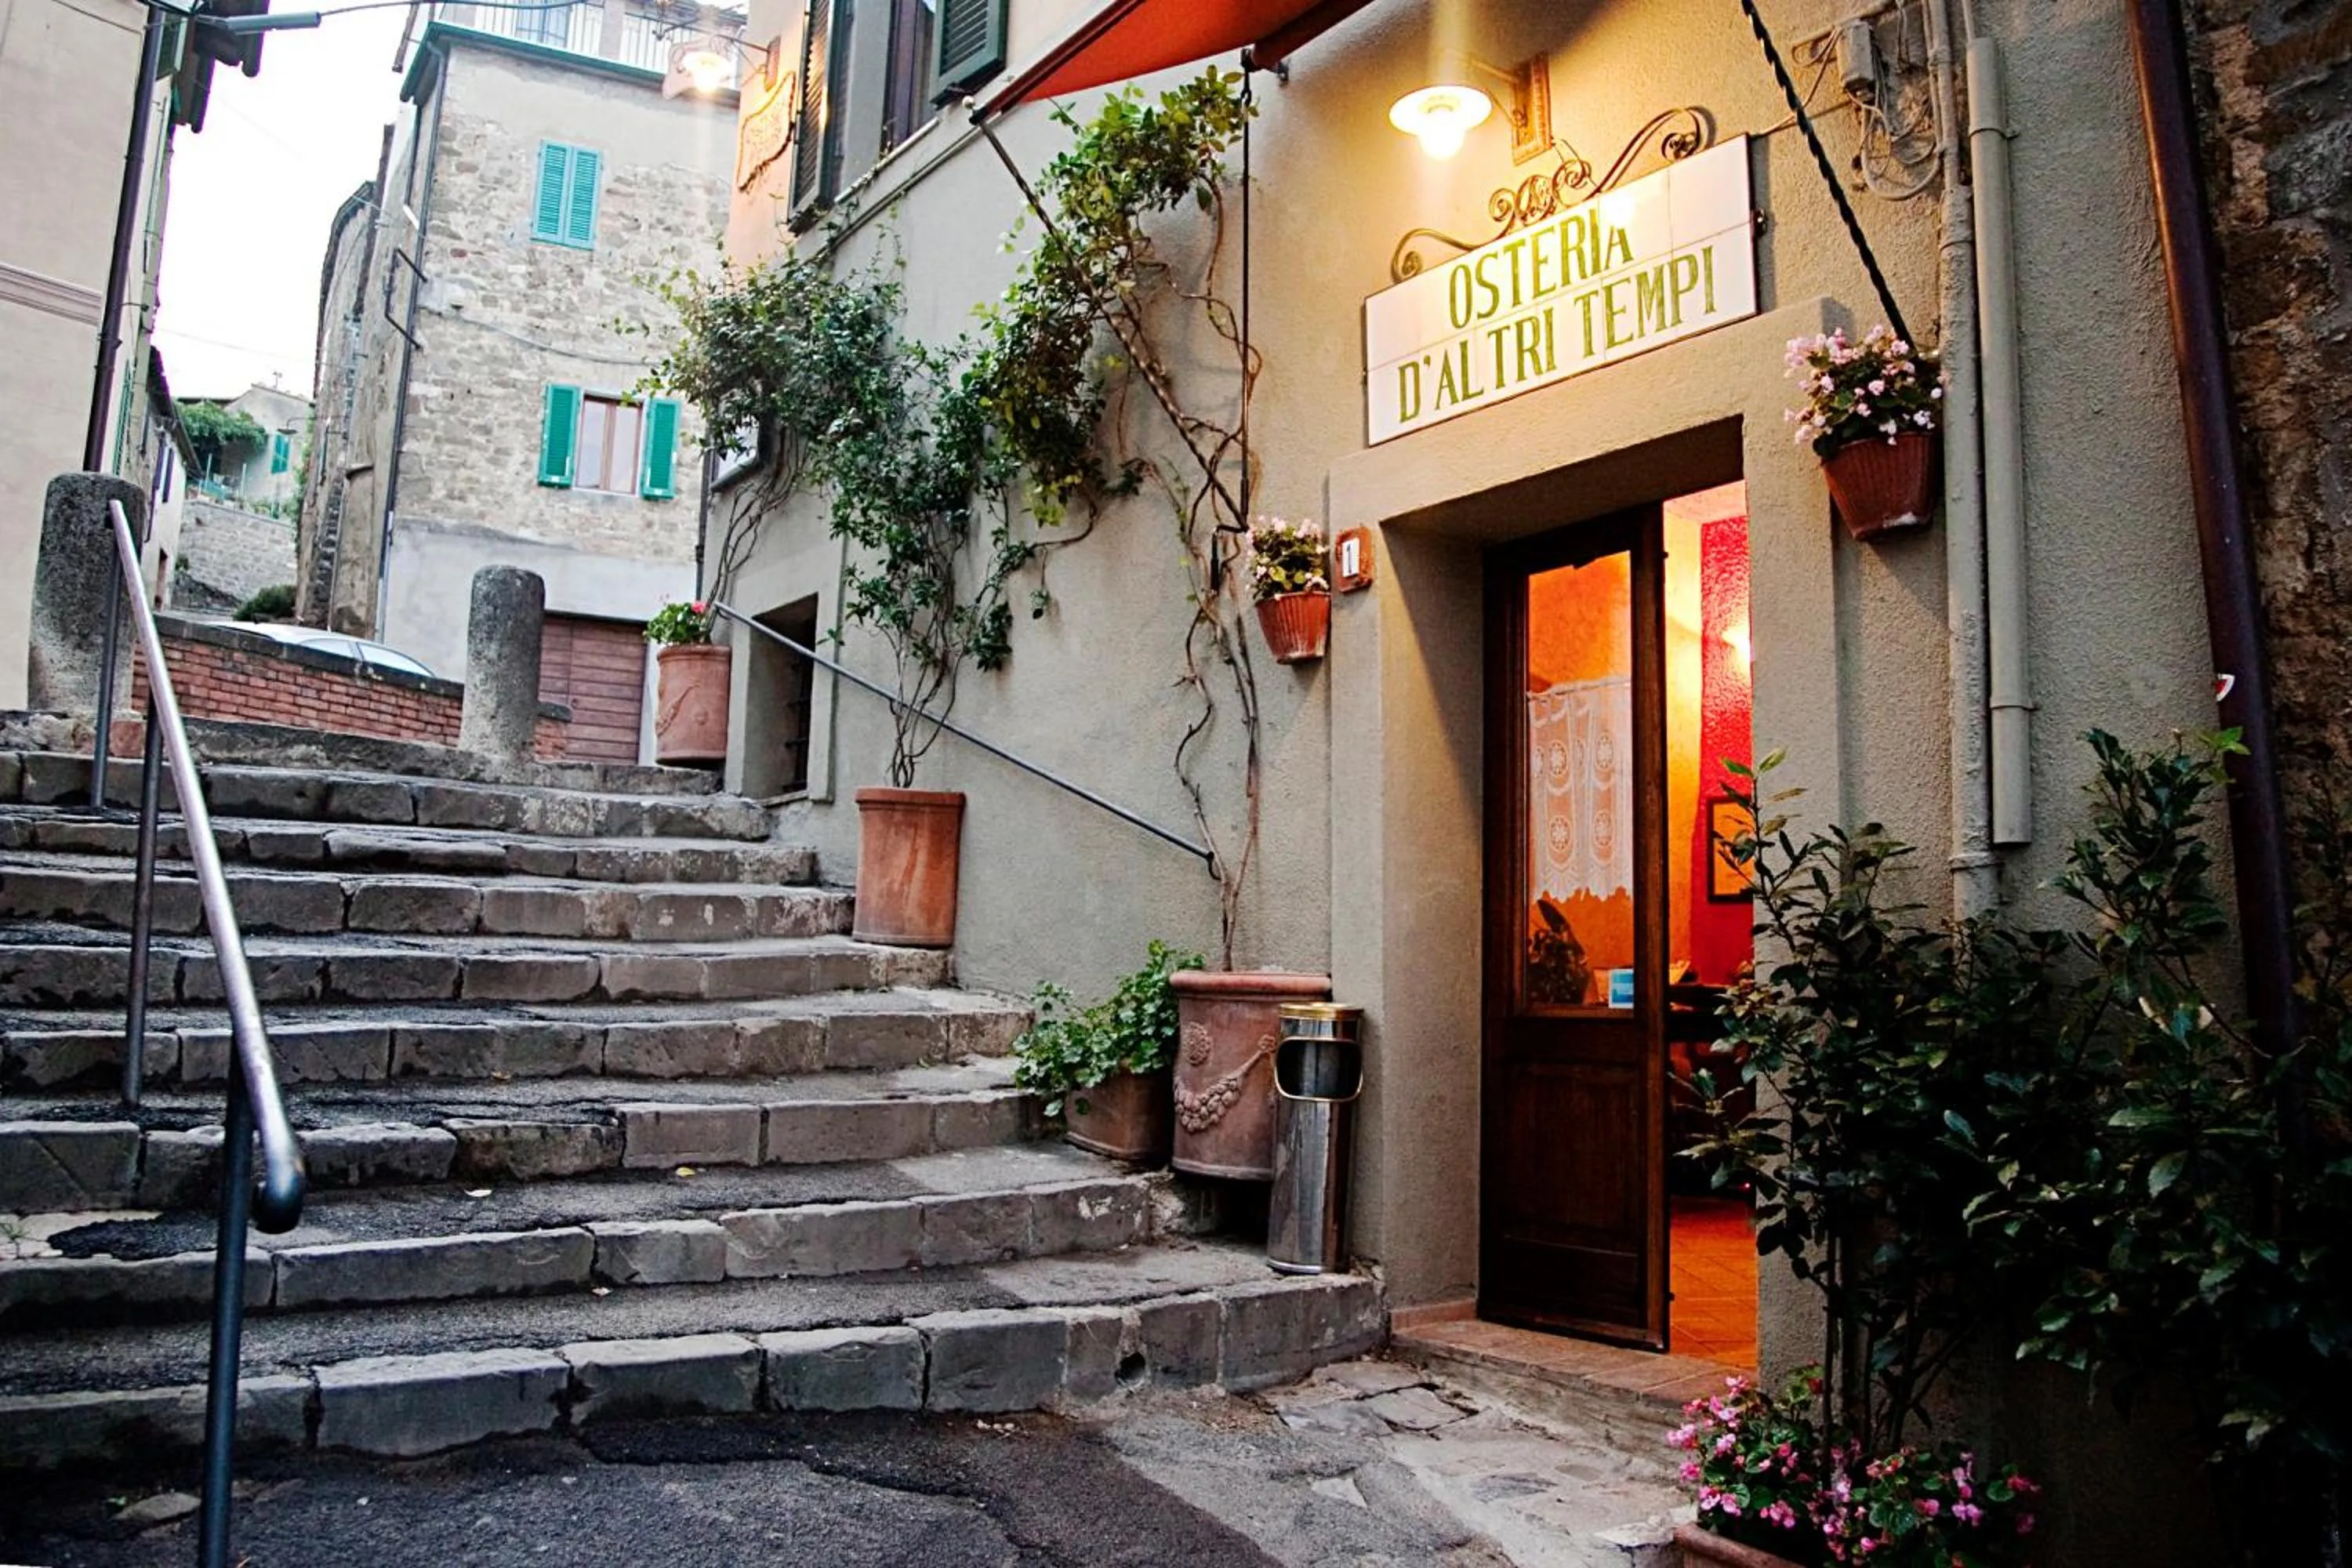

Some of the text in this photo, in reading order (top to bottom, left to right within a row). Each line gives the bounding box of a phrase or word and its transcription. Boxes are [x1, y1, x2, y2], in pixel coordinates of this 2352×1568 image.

[1397, 245, 1717, 423] D'ALTRI TEMPI
[1449, 209, 1634, 329] OSTERIA
